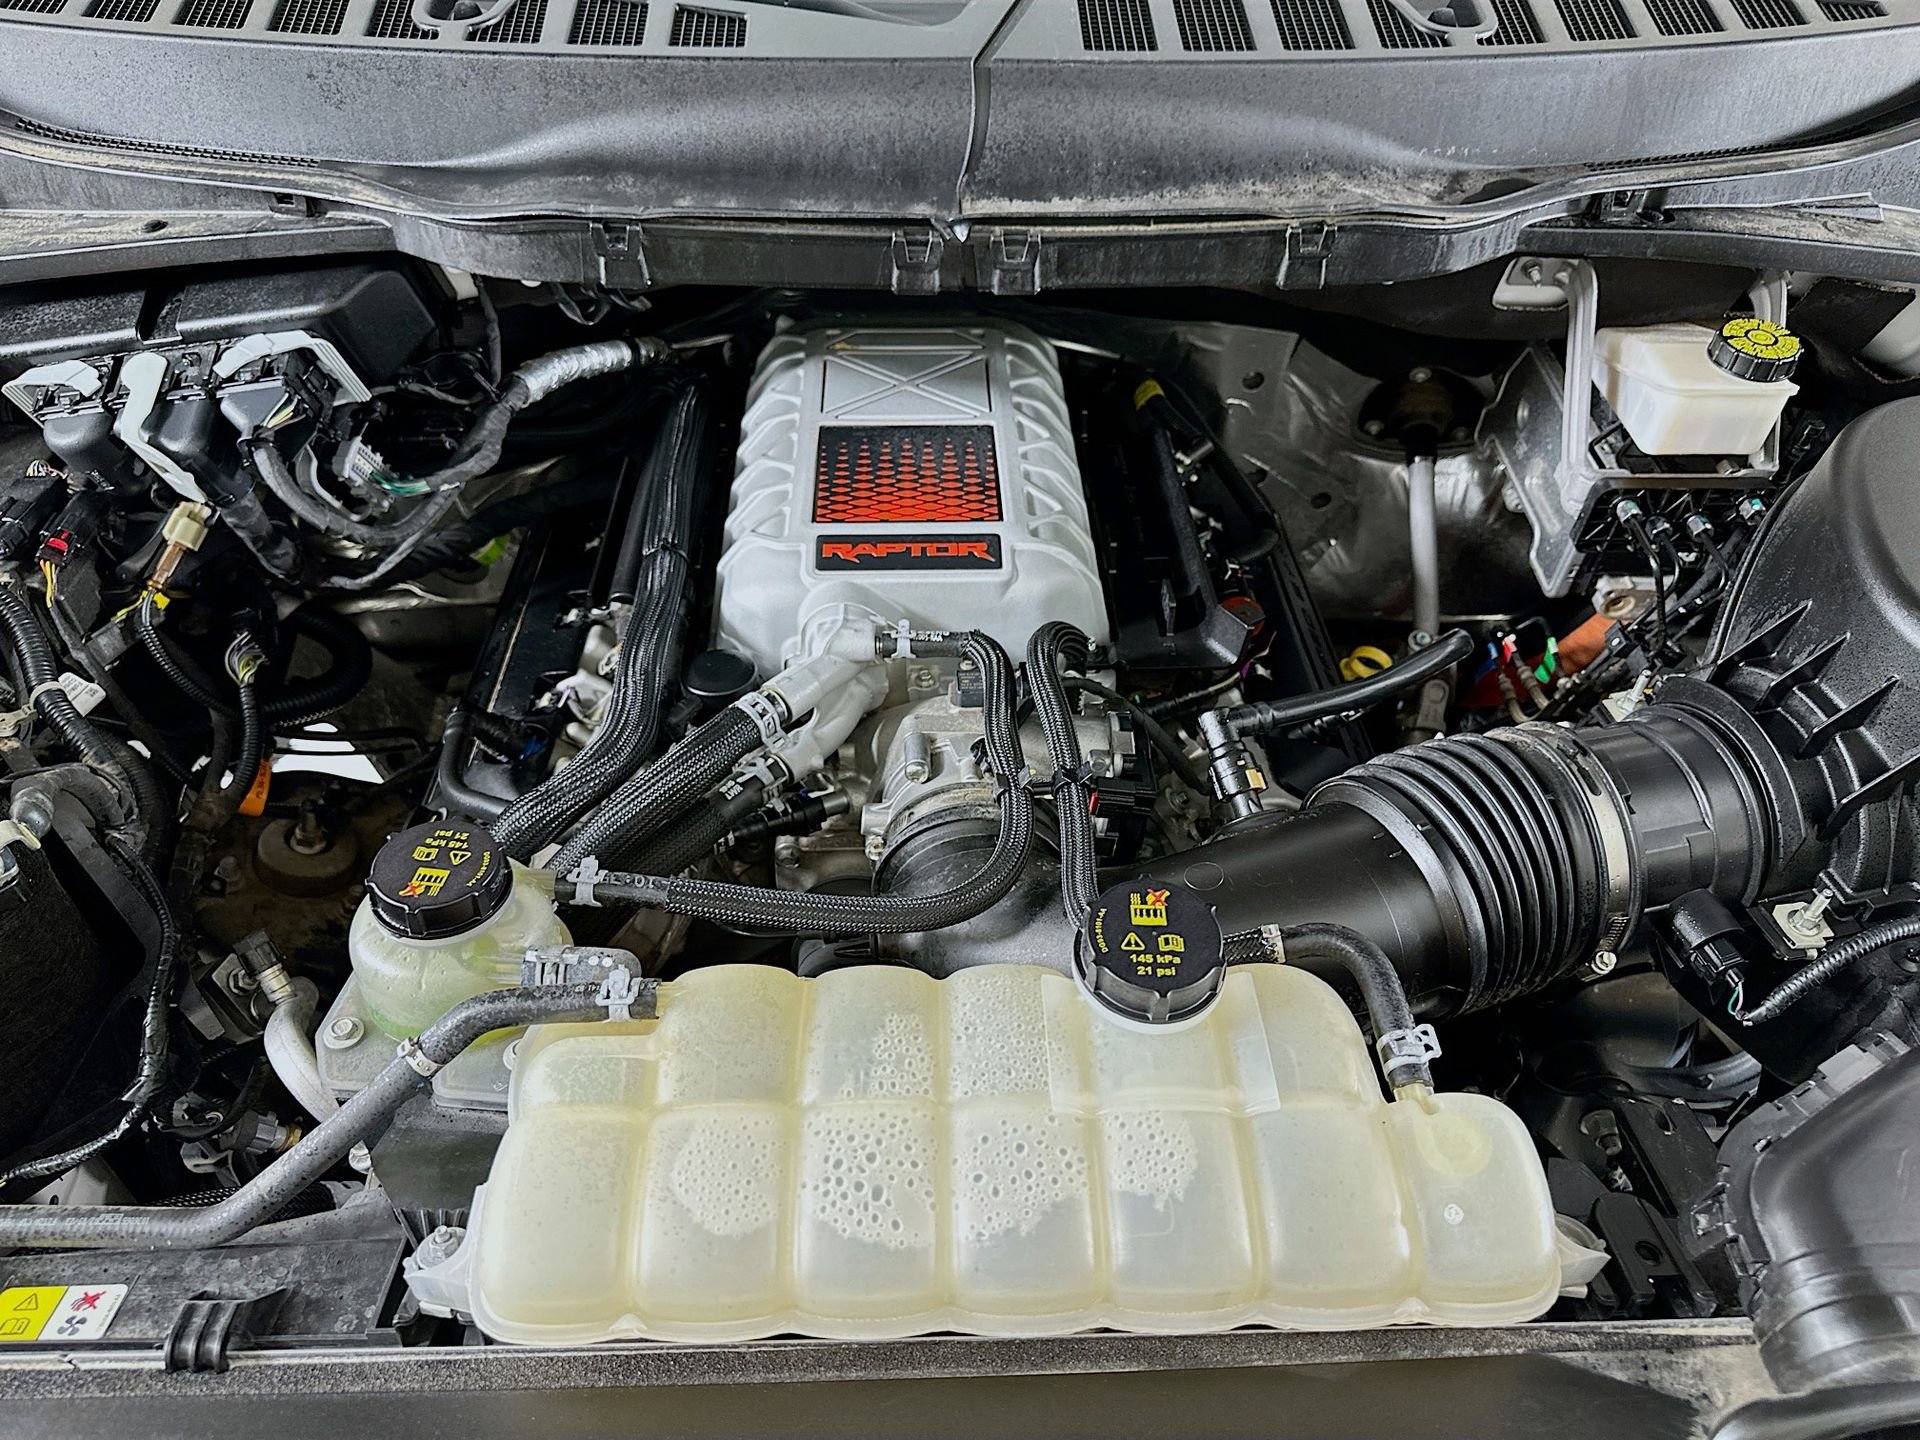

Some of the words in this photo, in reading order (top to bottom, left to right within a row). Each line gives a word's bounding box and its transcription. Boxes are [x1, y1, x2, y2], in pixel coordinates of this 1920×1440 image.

[821, 542, 996, 564] RAPTOR
[434, 829, 454, 838] psi
[454, 832, 470, 841] 21
[424, 837, 448, 848] kPa
[447, 840, 470, 850] 145
[1129, 954, 1154, 964] 145
[1156, 954, 1182, 964] kPa
[1136, 967, 1152, 976] 21
[1156, 967, 1176, 978] psi
